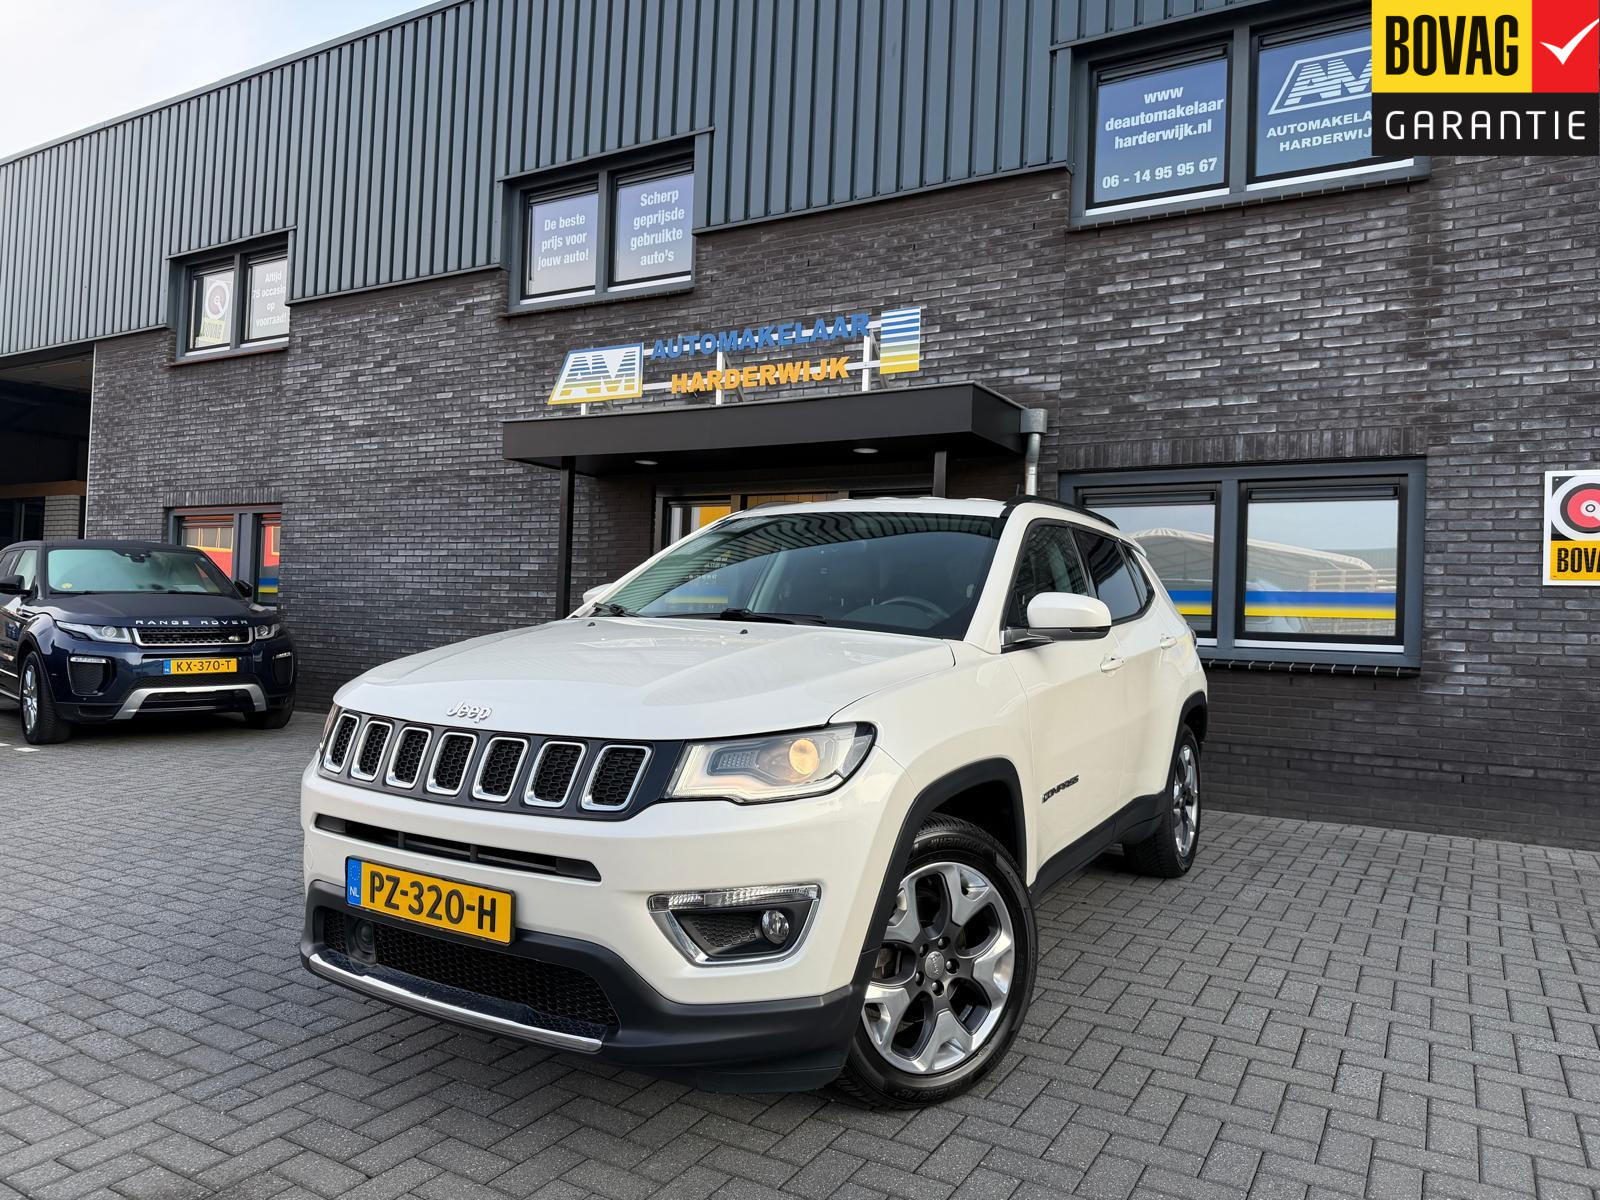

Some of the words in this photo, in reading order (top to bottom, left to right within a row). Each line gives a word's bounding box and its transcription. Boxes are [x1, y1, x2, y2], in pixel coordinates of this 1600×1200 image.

[1144, 86, 1184, 104] www
[1105, 98, 1224, 131] deautomakelaar
[1114, 119, 1212, 150] harderwijk.nl
[1279, 127, 1372, 152] HARDERWIJ
[1102, 175, 1120, 189] 06
[1133, 169, 1151, 184] 14
[1154, 165, 1173, 180] 95
[1176, 162, 1195, 177] 95
[1198, 157, 1218, 173] 67
[640, 189, 679, 207] Scherp
[544, 218, 557, 231] De
[559, 213, 586, 229] beste
[633, 206, 685, 230] geprijsde
[541, 234, 563, 252] prijs
[565, 231, 588, 246] voor
[630, 228, 683, 251] gebruikte
[537, 255, 561, 271] jouw
[563, 248, 589, 264] auto!
[640, 249, 674, 266] auto's
[266, 302, 276, 312] op
[650, 313, 870, 361] AUTOMAKELAAR
[671, 356, 849, 394] HARDERWIJK
[1556, 547, 1600, 573] BOV
[176, 659, 232, 672] KX-370-T
[446, 700, 492, 724] Jeep
[349, 886, 360, 898] NL
[369, 870, 497, 933] PZ-320-H
